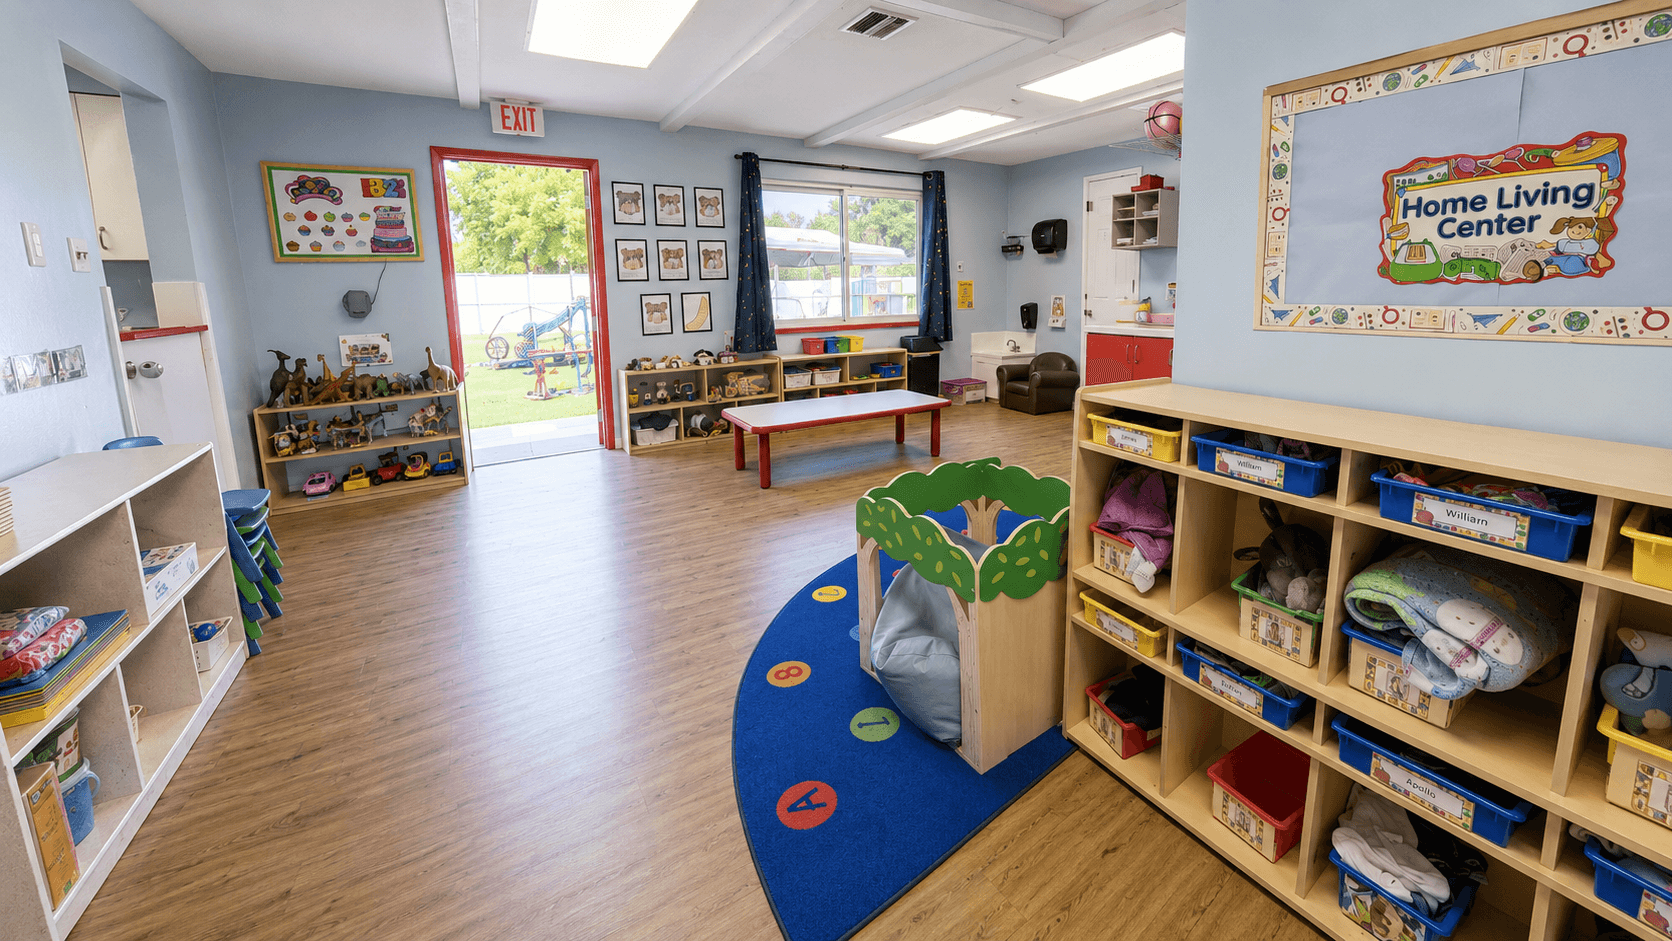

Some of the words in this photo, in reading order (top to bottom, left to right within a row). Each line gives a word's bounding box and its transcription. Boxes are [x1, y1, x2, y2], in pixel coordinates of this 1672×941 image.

[500, 104, 537, 132] EXIT
[1402, 194, 1488, 219] Home
[1496, 181, 1596, 209] Living
[1437, 212, 1542, 239] Center
[787, 787, 827, 813] A
